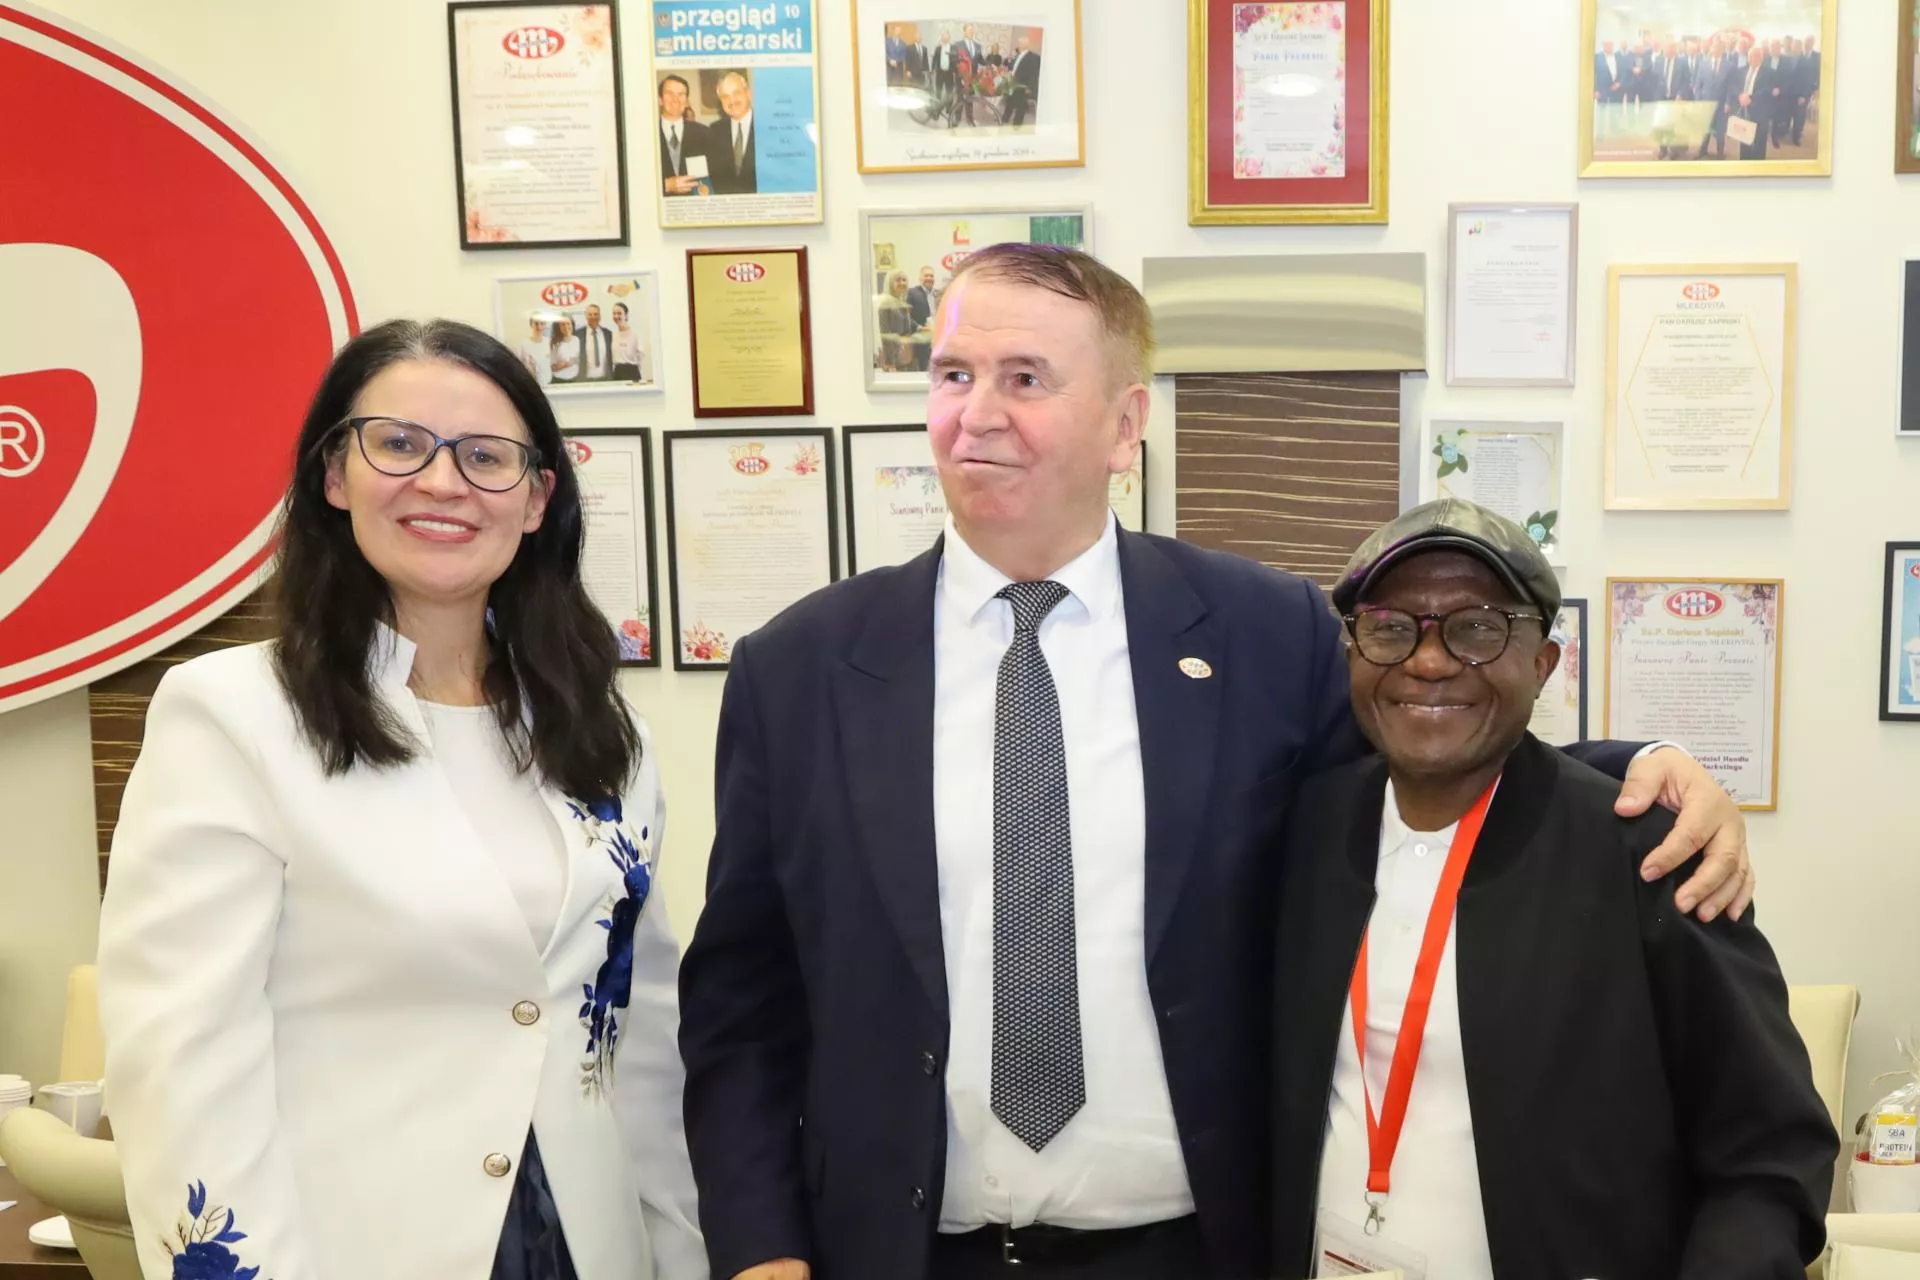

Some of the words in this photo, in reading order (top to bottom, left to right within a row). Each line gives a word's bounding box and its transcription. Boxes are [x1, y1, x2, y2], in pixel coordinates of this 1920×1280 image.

[672, 3, 777, 32] przegląd
[784, 5, 800, 19] 10
[672, 28, 802, 51] mleczarski
